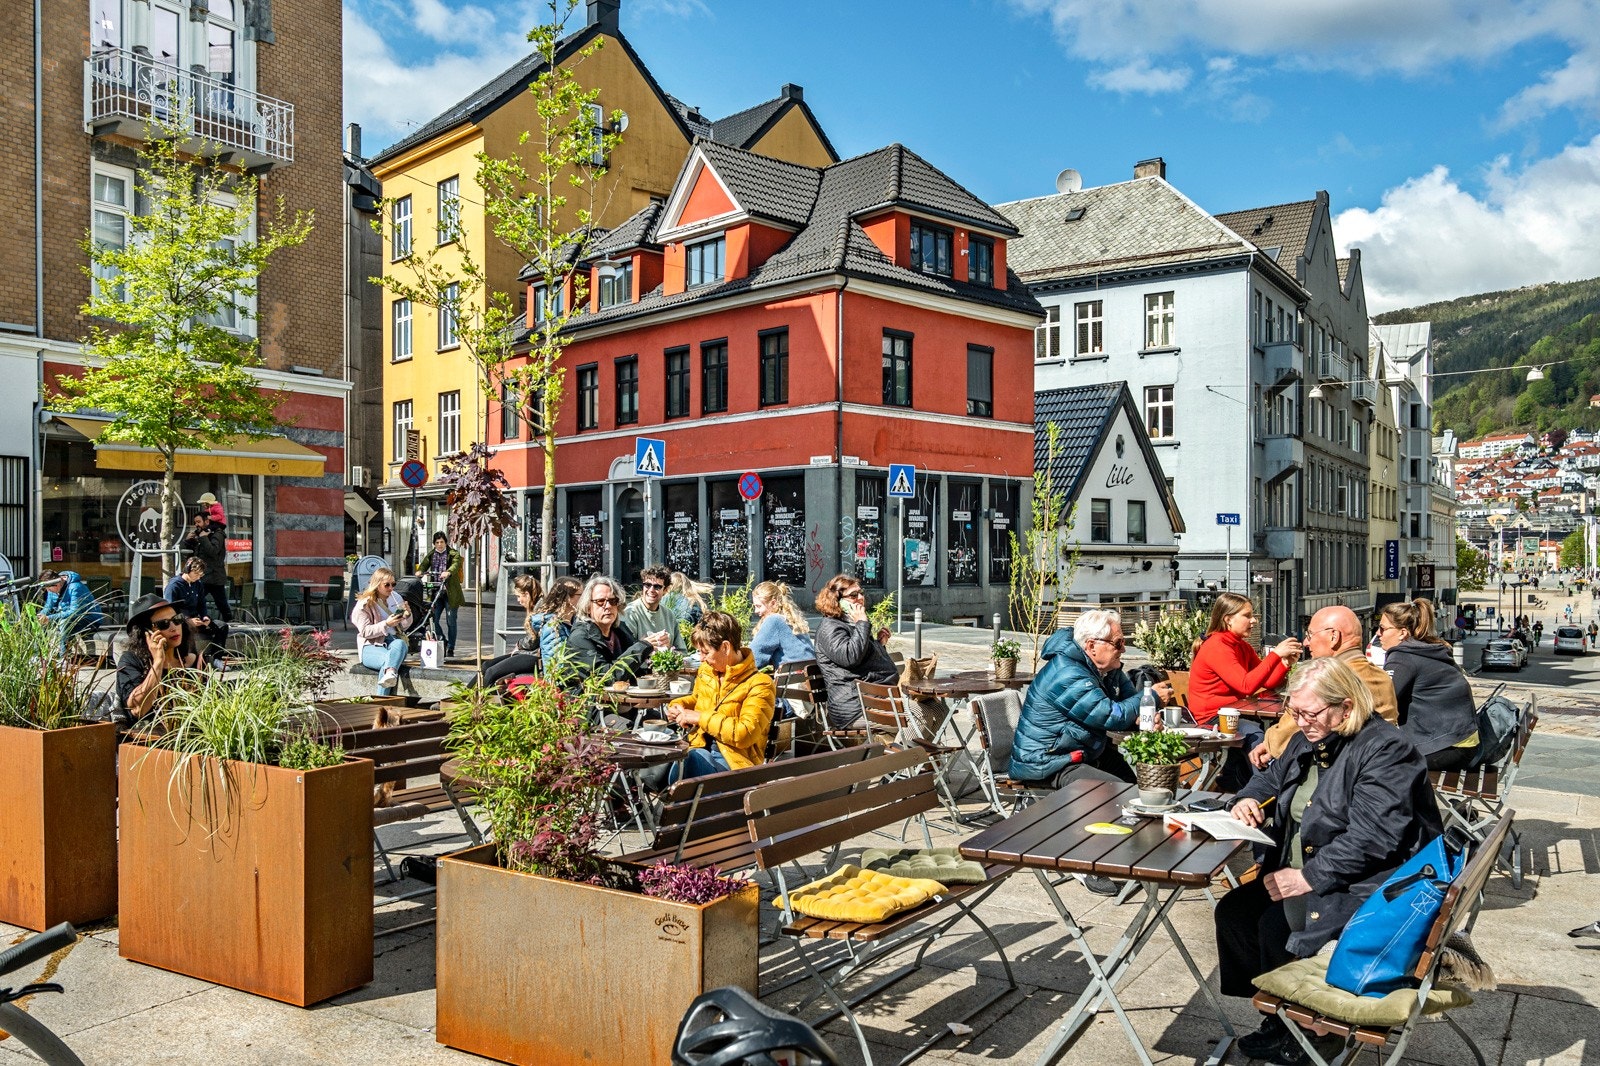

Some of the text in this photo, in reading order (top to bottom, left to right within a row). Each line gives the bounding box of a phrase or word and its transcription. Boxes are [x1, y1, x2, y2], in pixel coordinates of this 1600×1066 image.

[1106, 464, 1134, 488] Lille
[126, 486, 176, 506] DROME
[1220, 515, 1237, 523] Taxi
[128, 532, 174, 550] KAFFE
